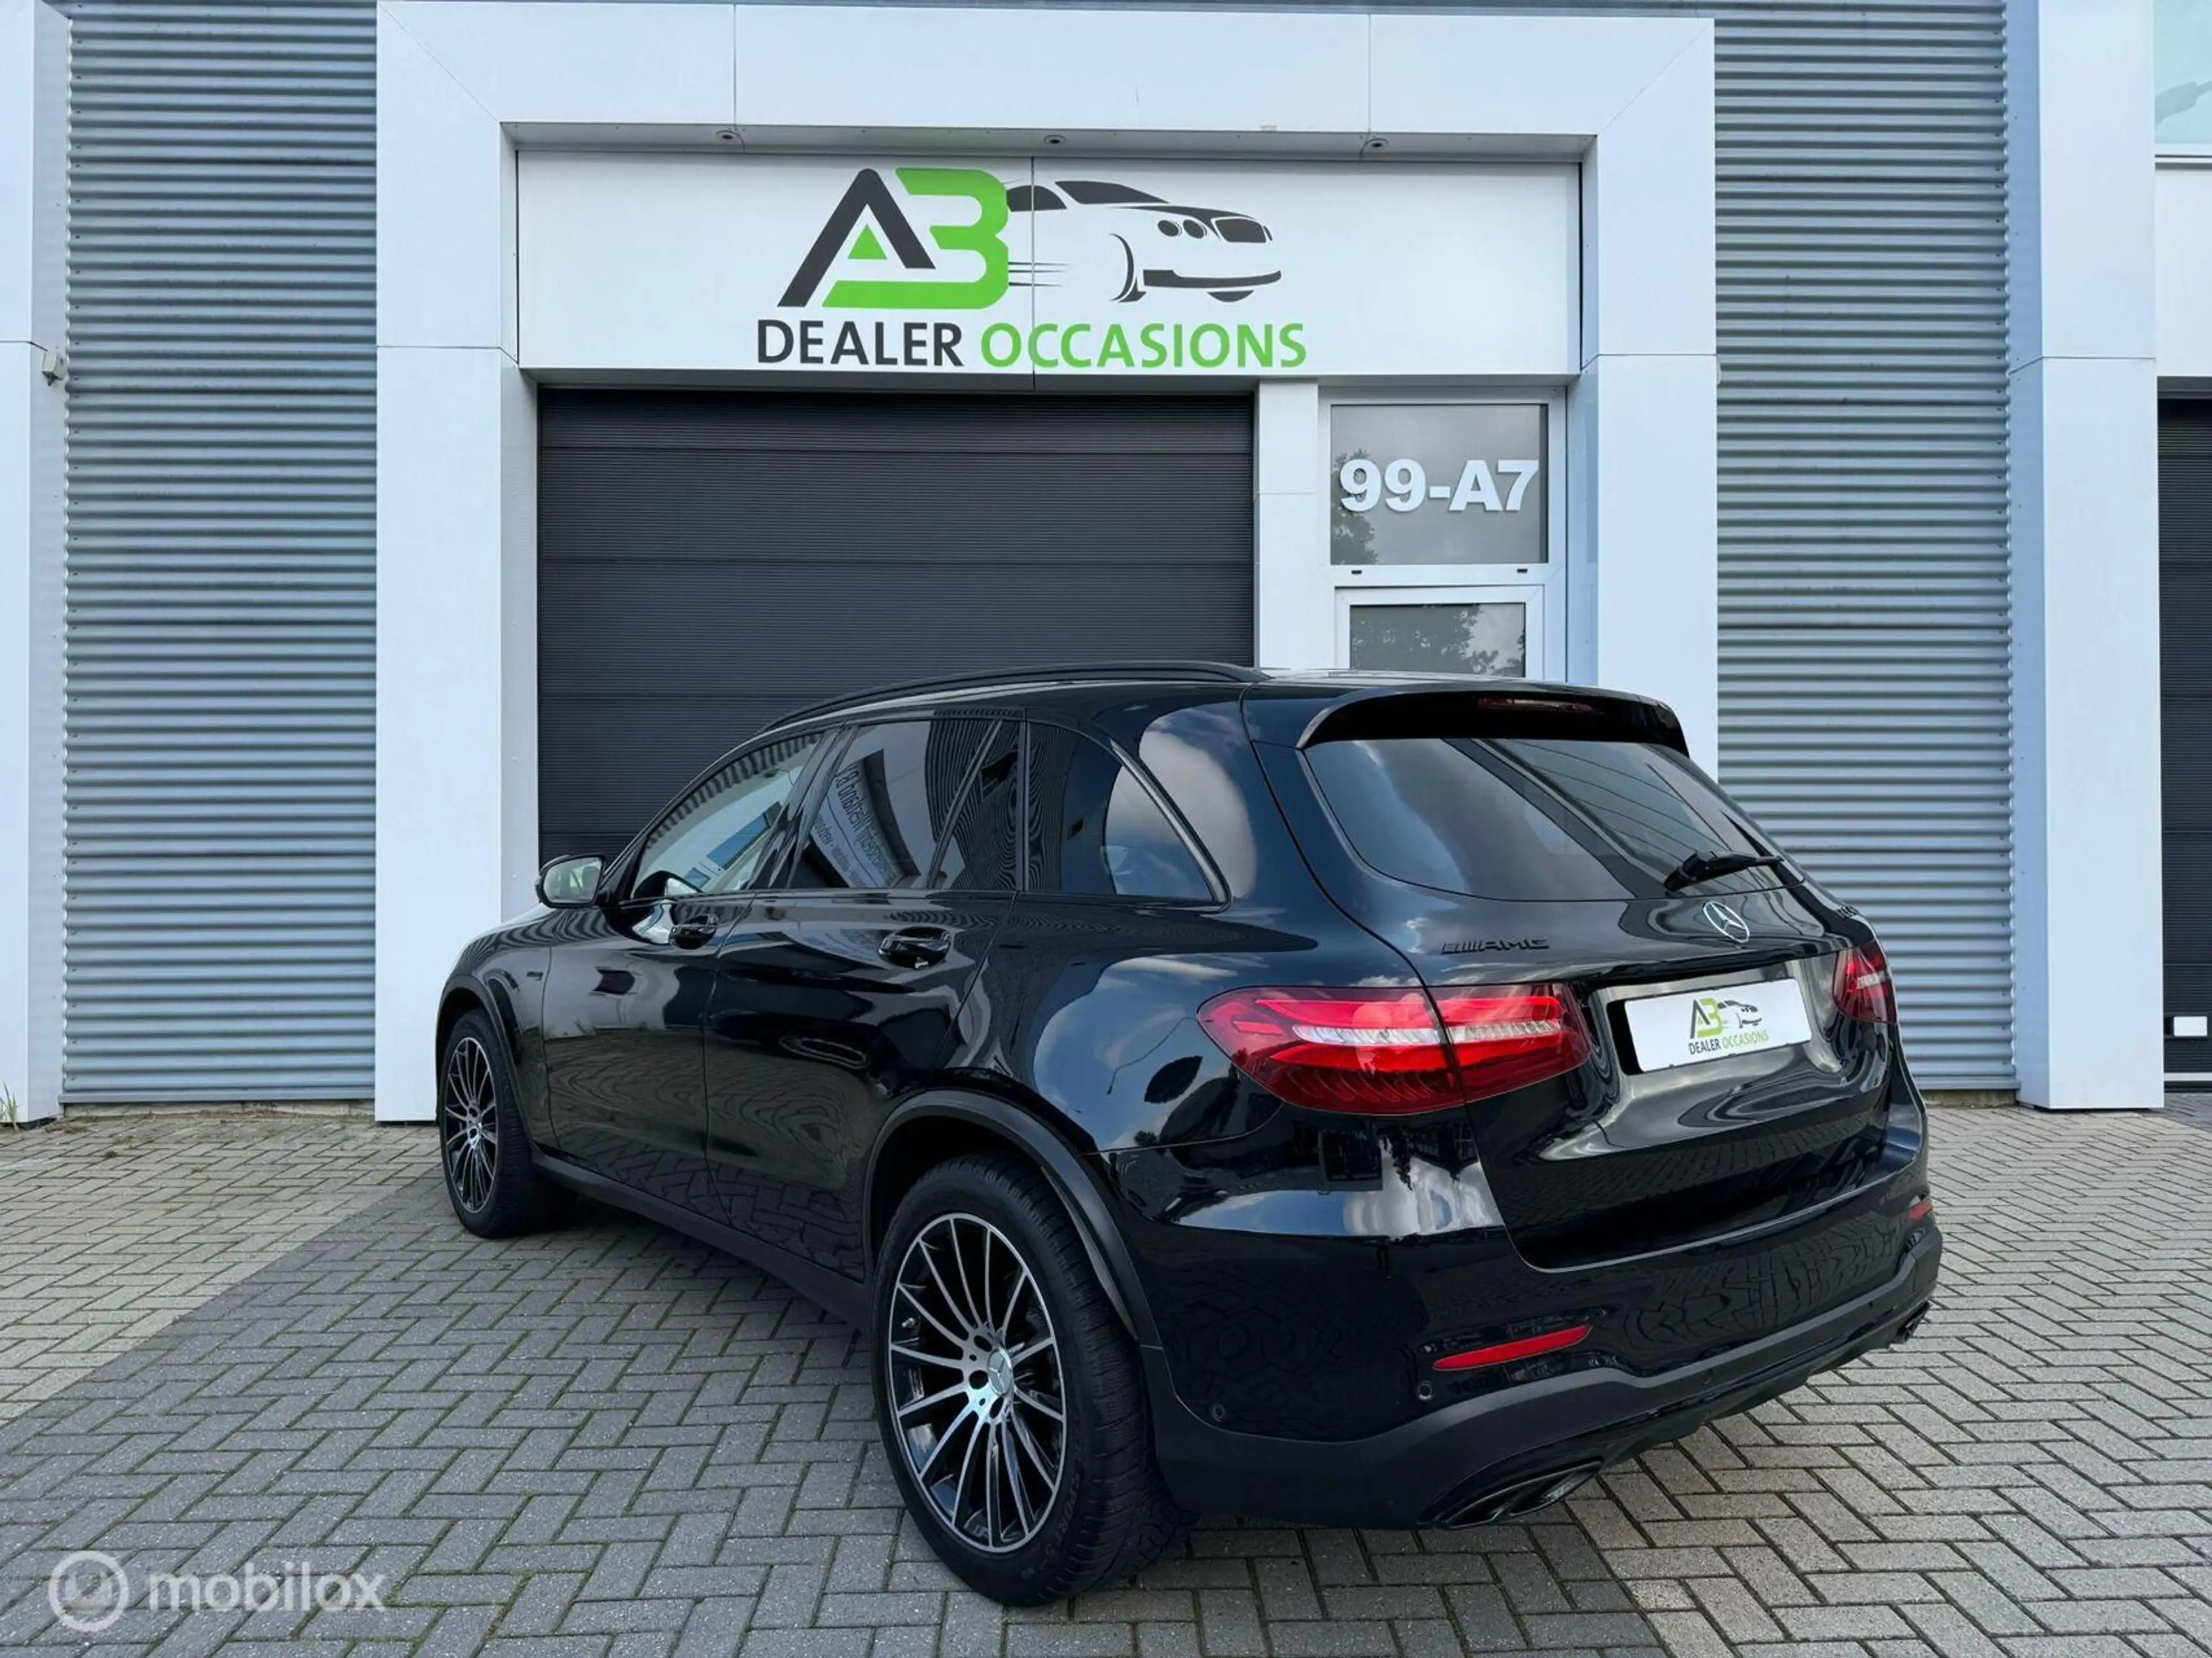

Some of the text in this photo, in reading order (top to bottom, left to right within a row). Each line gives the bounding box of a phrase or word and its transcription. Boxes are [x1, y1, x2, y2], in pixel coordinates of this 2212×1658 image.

[757, 319, 1307, 369] DEALER OCCASIONS
[1339, 458, 1539, 511] 99-A7
[1688, 1029, 1770, 1056] DEALER OCCASIONS
